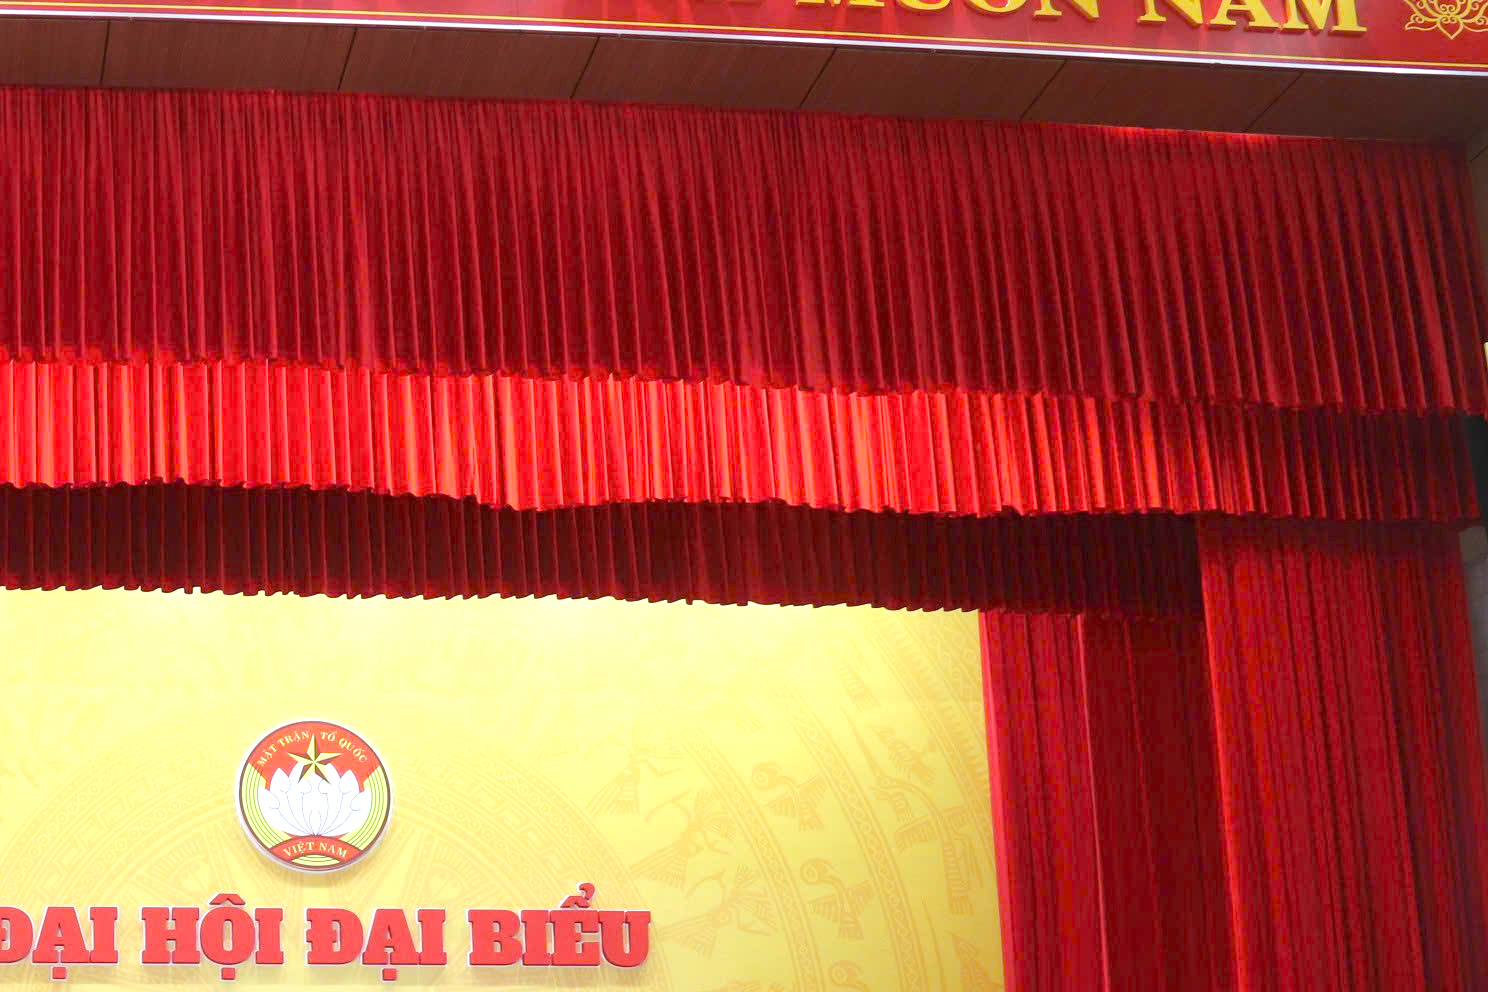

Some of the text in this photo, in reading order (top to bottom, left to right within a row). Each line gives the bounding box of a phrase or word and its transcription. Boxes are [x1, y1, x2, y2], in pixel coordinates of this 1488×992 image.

[256, 730, 368, 767] MẶT TRẬN TỔ QUỐC
[283, 841, 348, 858] VIỆT NAM
[141, 893, 284, 980] HỘI
[306, 907, 448, 981] ĐẠI
[468, 883, 652, 968] BIỂU
